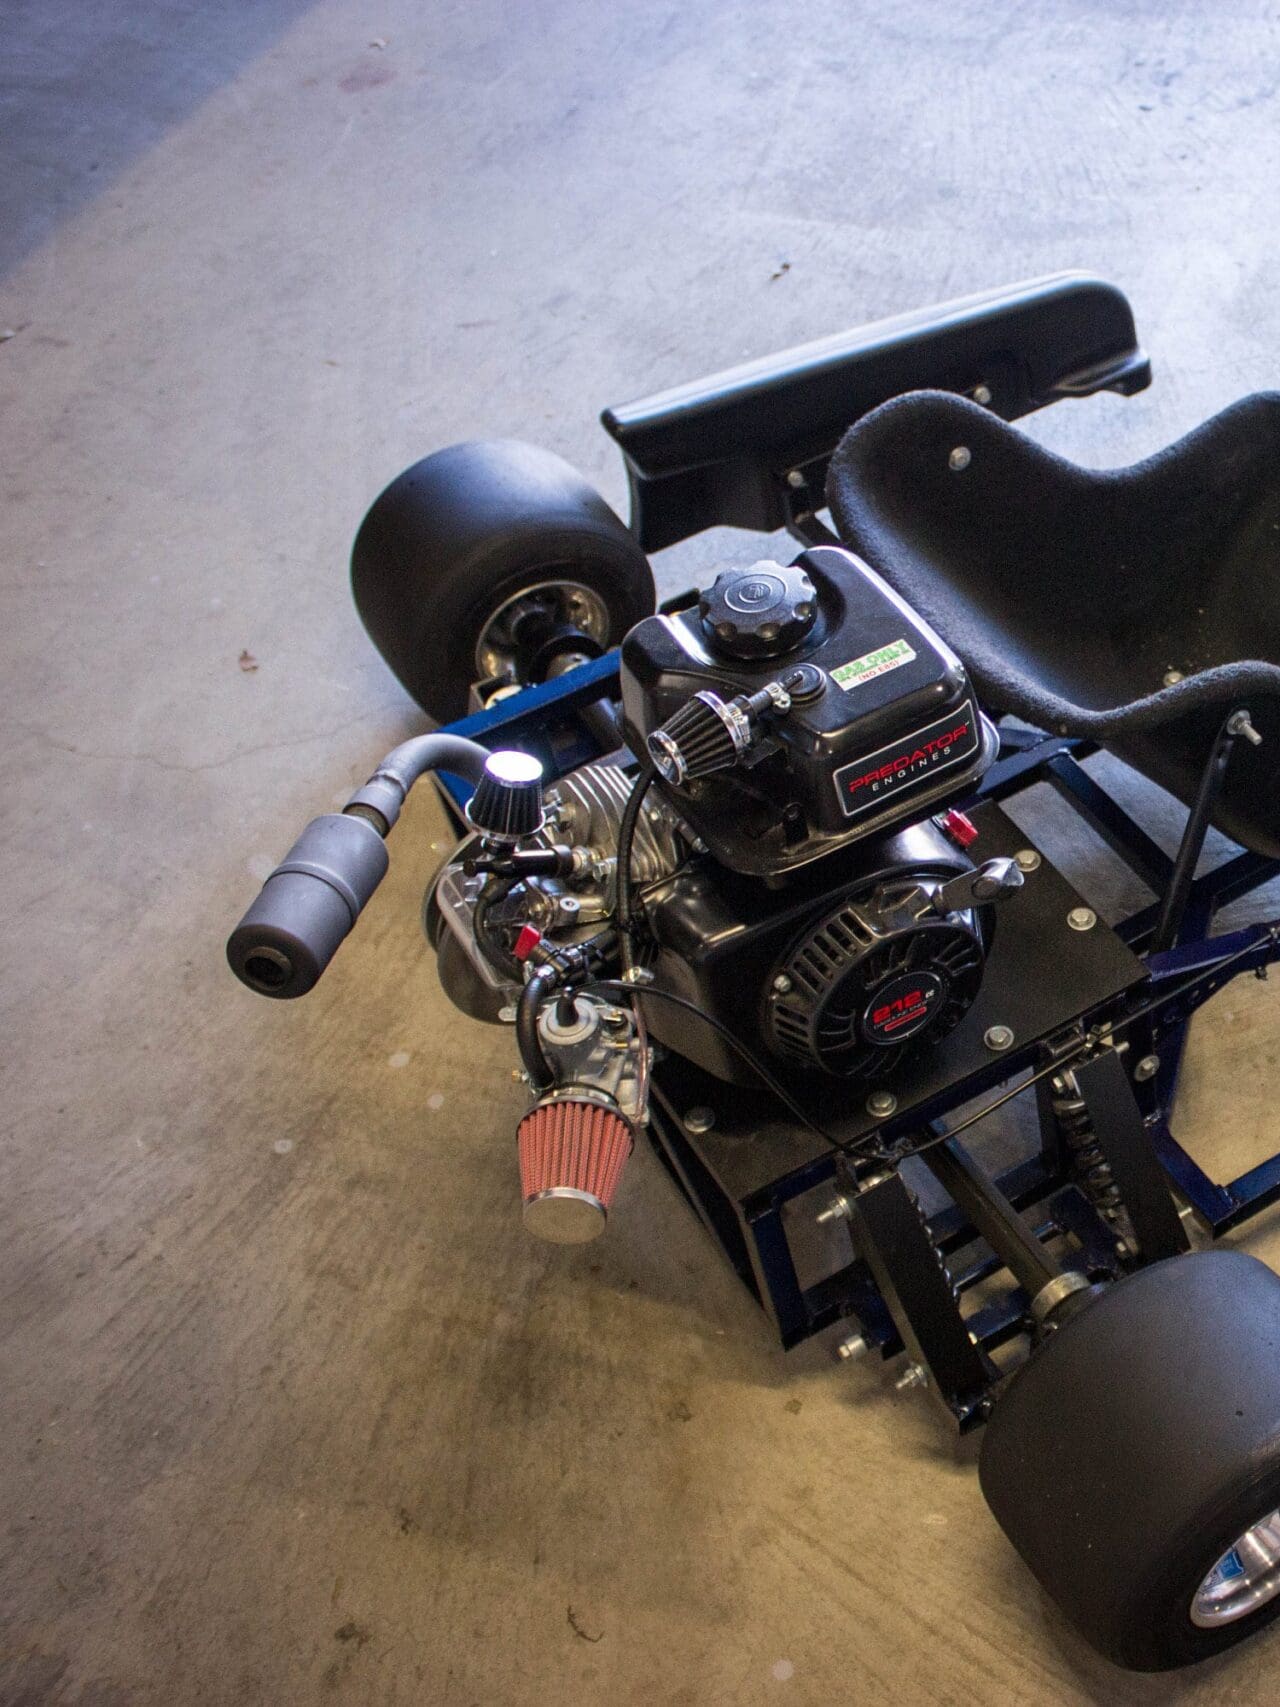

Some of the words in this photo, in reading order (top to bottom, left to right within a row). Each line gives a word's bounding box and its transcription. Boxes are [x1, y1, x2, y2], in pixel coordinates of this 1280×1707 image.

[832, 661, 864, 682] GAS
[866, 641, 910, 663] ONLY
[849, 725, 967, 793] PREDATOR
[872, 746, 950, 791] ENGINES
[873, 991, 921, 1024] 212
